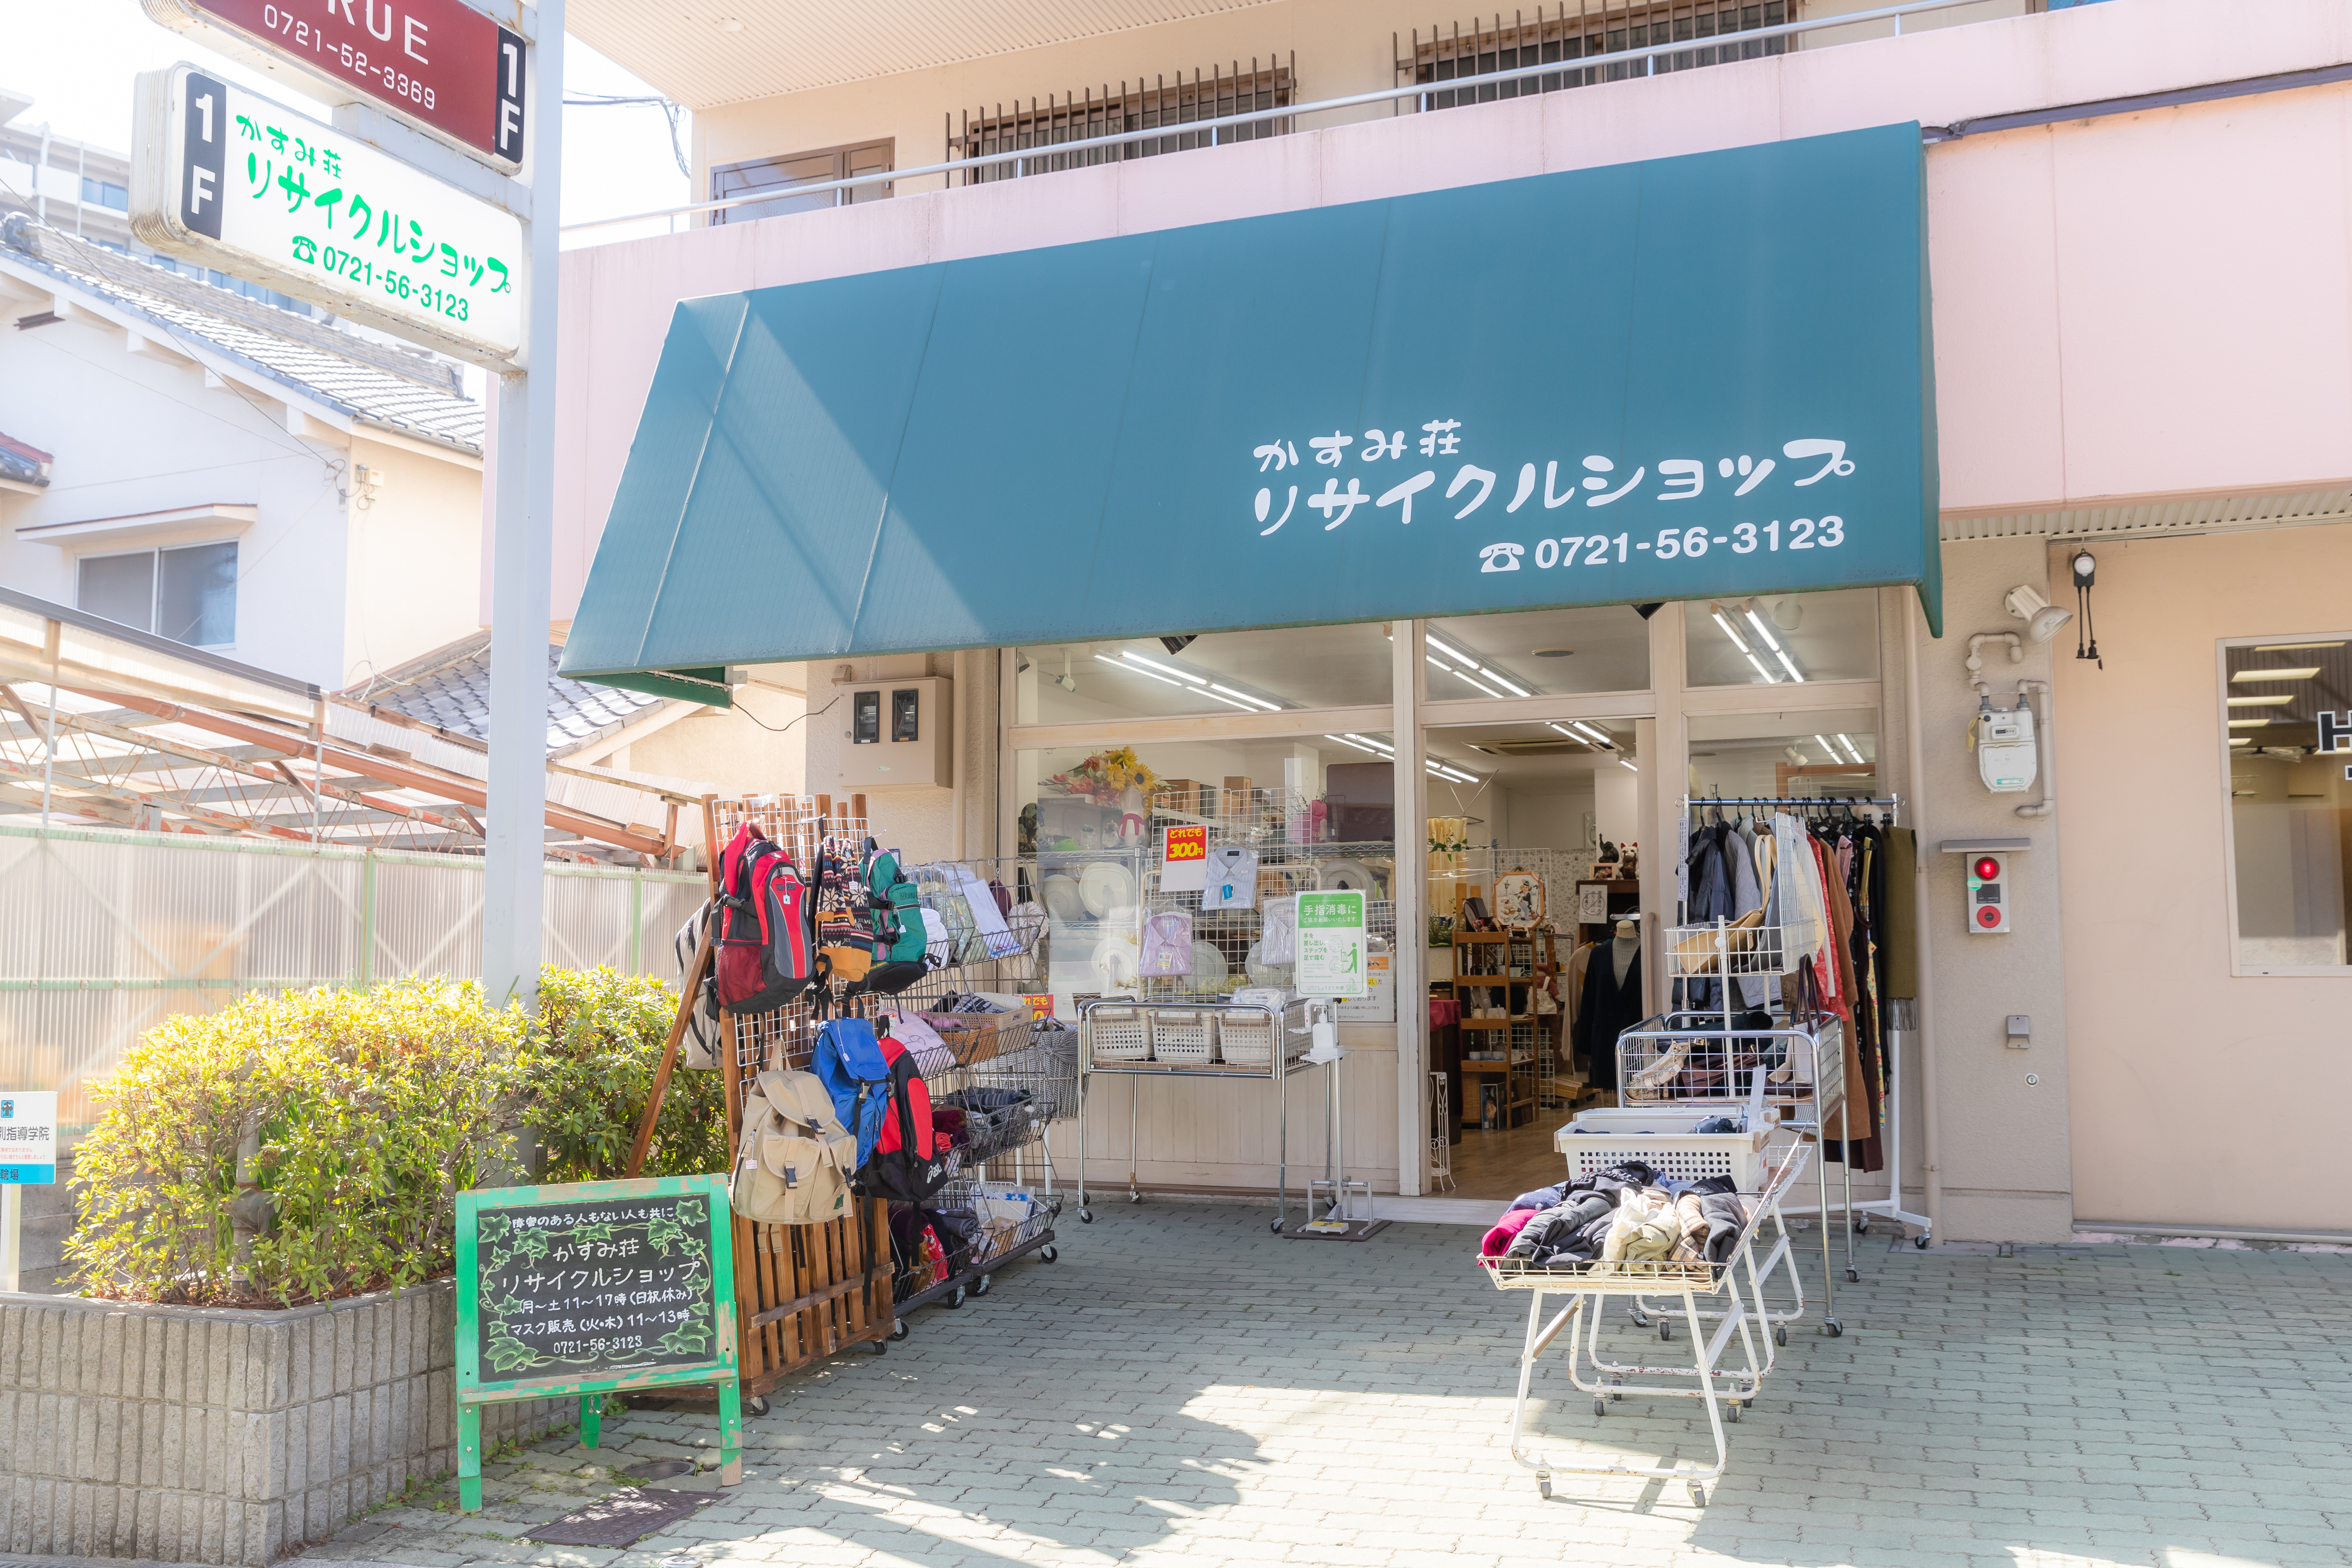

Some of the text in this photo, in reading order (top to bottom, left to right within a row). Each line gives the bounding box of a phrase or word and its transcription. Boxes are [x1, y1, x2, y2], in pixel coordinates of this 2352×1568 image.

[264, 4, 435, 110] 0721-52-3369
[500, 43, 521, 151] 1F
[191, 93, 215, 215] 1F
[236, 115, 342, 179] かすみ荘
[247, 152, 512, 294] リサイクルショップ
[323, 246, 469, 322] 0721-56-3123
[1253, 418, 1462, 472] かすみ荘
[1254, 438, 1856, 536] リサイクルショップ
[1534, 515, 1845, 568] 0721-56-3123
[1169, 828, 1203, 838] どれでも
[1169, 842, 1203, 858] 300円
[1303, 904, 1357, 915] 手指消毒に
[512, 1207, 674, 1229] 障害のある人もない人も共に
[553, 1238, 640, 1262] かすみ荘
[503, 1261, 700, 1294] リサイクルショップ
[554, 1335, 643, 1354] 0721-56-3123
